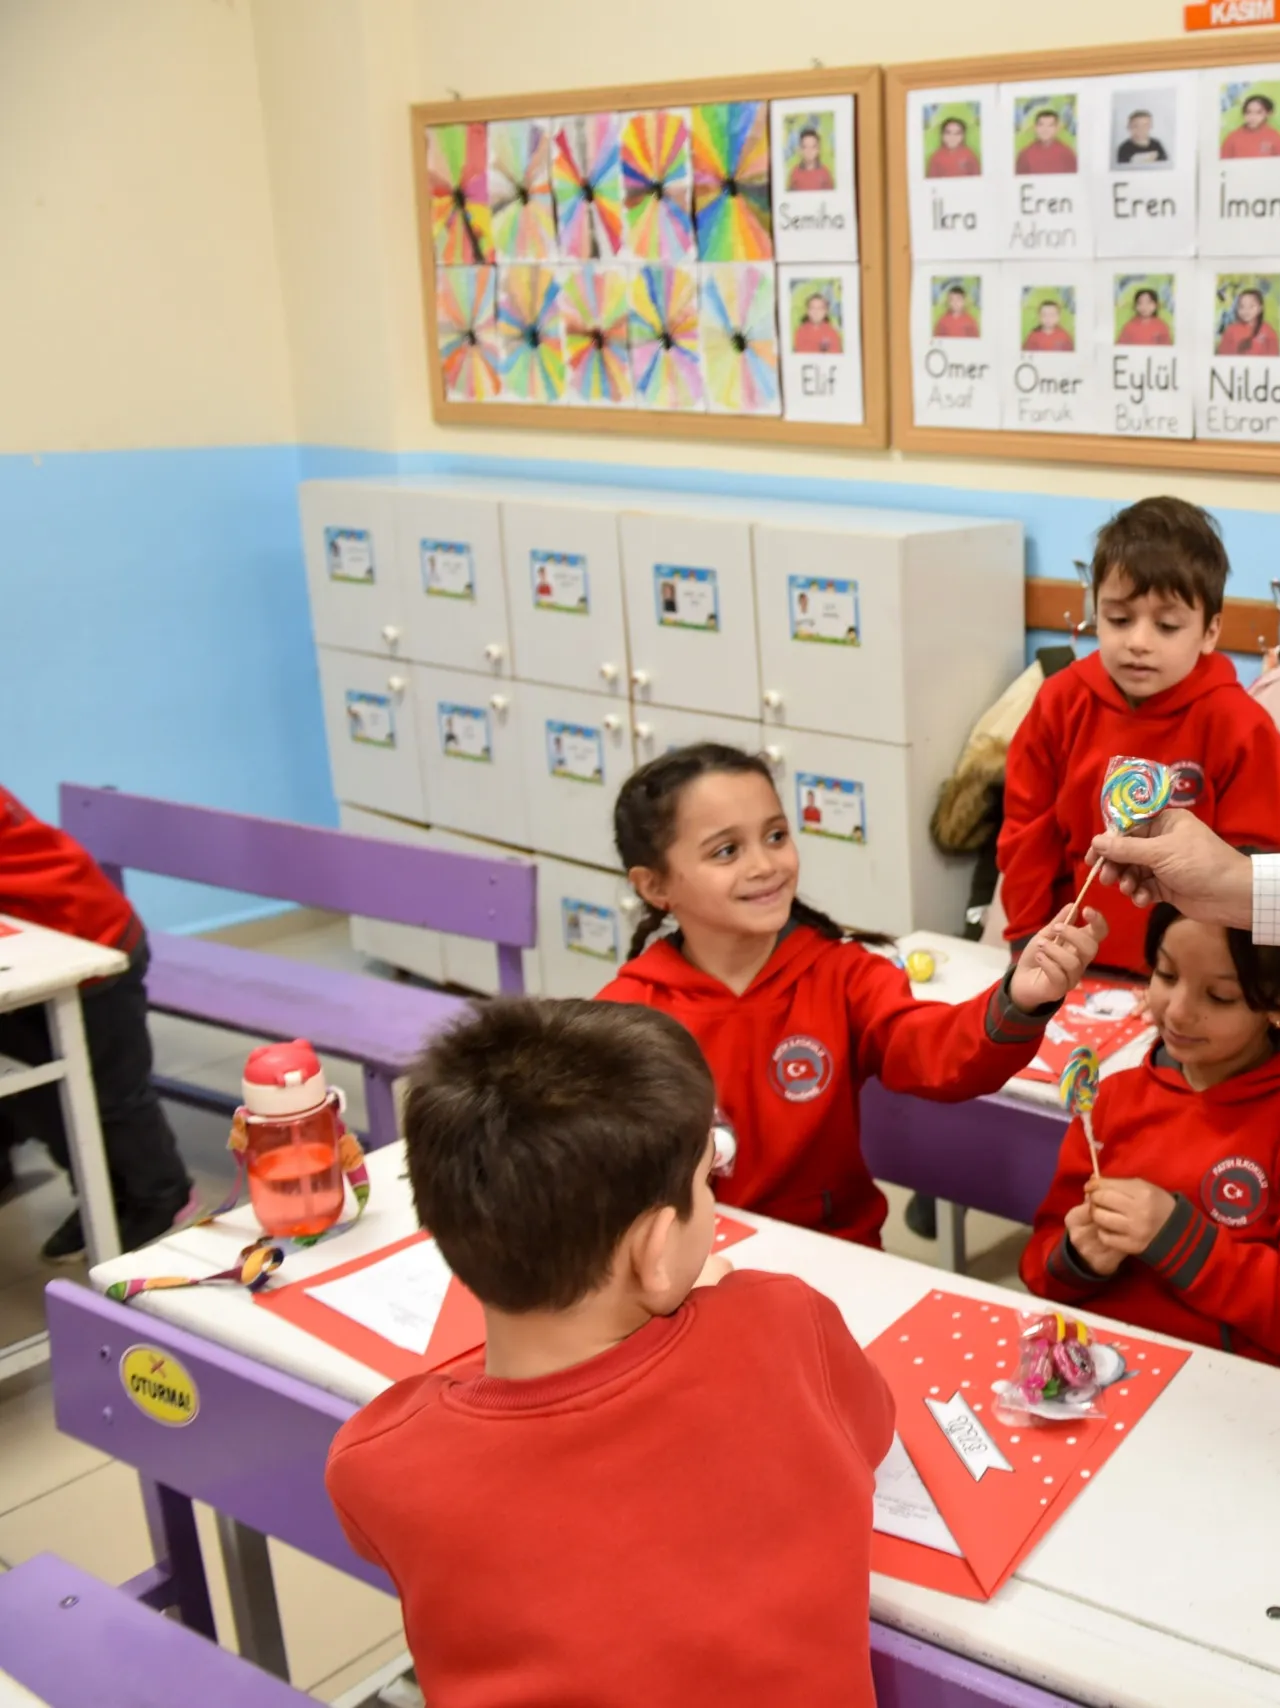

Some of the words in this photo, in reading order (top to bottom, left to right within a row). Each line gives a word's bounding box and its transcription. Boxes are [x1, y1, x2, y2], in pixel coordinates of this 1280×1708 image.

[779, 202, 845, 231] Semiha
[932, 186, 977, 231] İkra
[1020, 183, 1073, 214] Eren
[1112, 181, 1177, 218] Eren
[801, 364, 838, 396] Elif
[1014, 354, 1084, 395] Ömer
[1112, 354, 1179, 404] Eylül
[1206, 406, 1279, 434] Ebrar
[130, 1373, 191, 1413] OTURMA!
